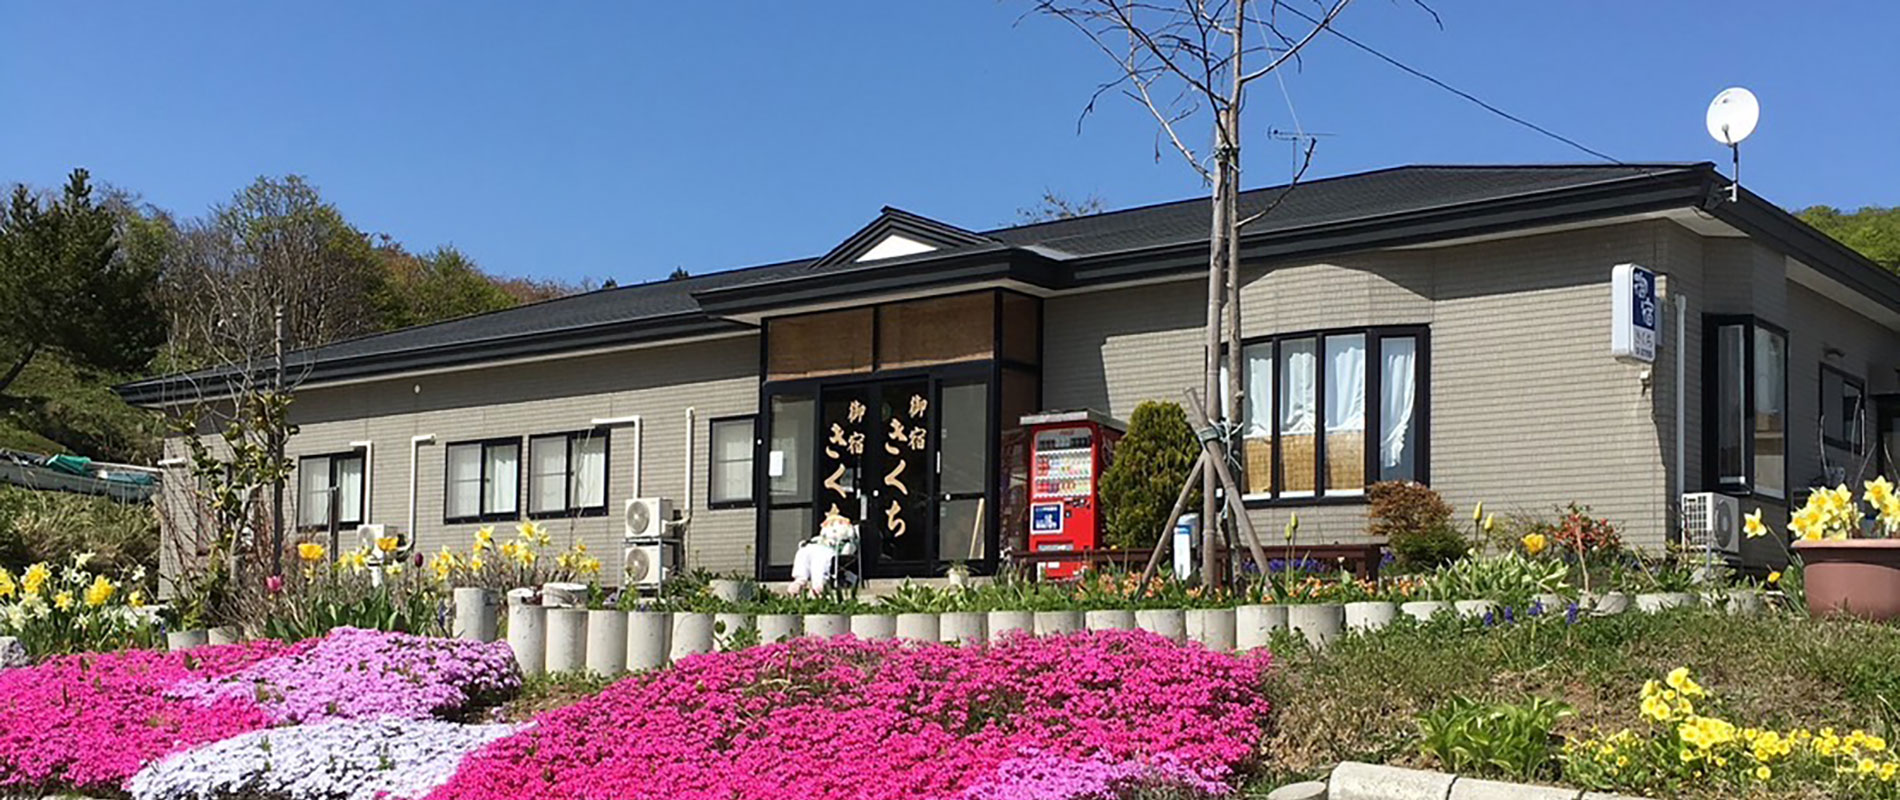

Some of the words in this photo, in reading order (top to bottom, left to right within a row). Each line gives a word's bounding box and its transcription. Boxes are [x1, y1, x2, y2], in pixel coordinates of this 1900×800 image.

[847, 400, 867, 455] 御宿
[908, 394, 929, 451] 御宿
[883, 418, 909, 538] きくち
